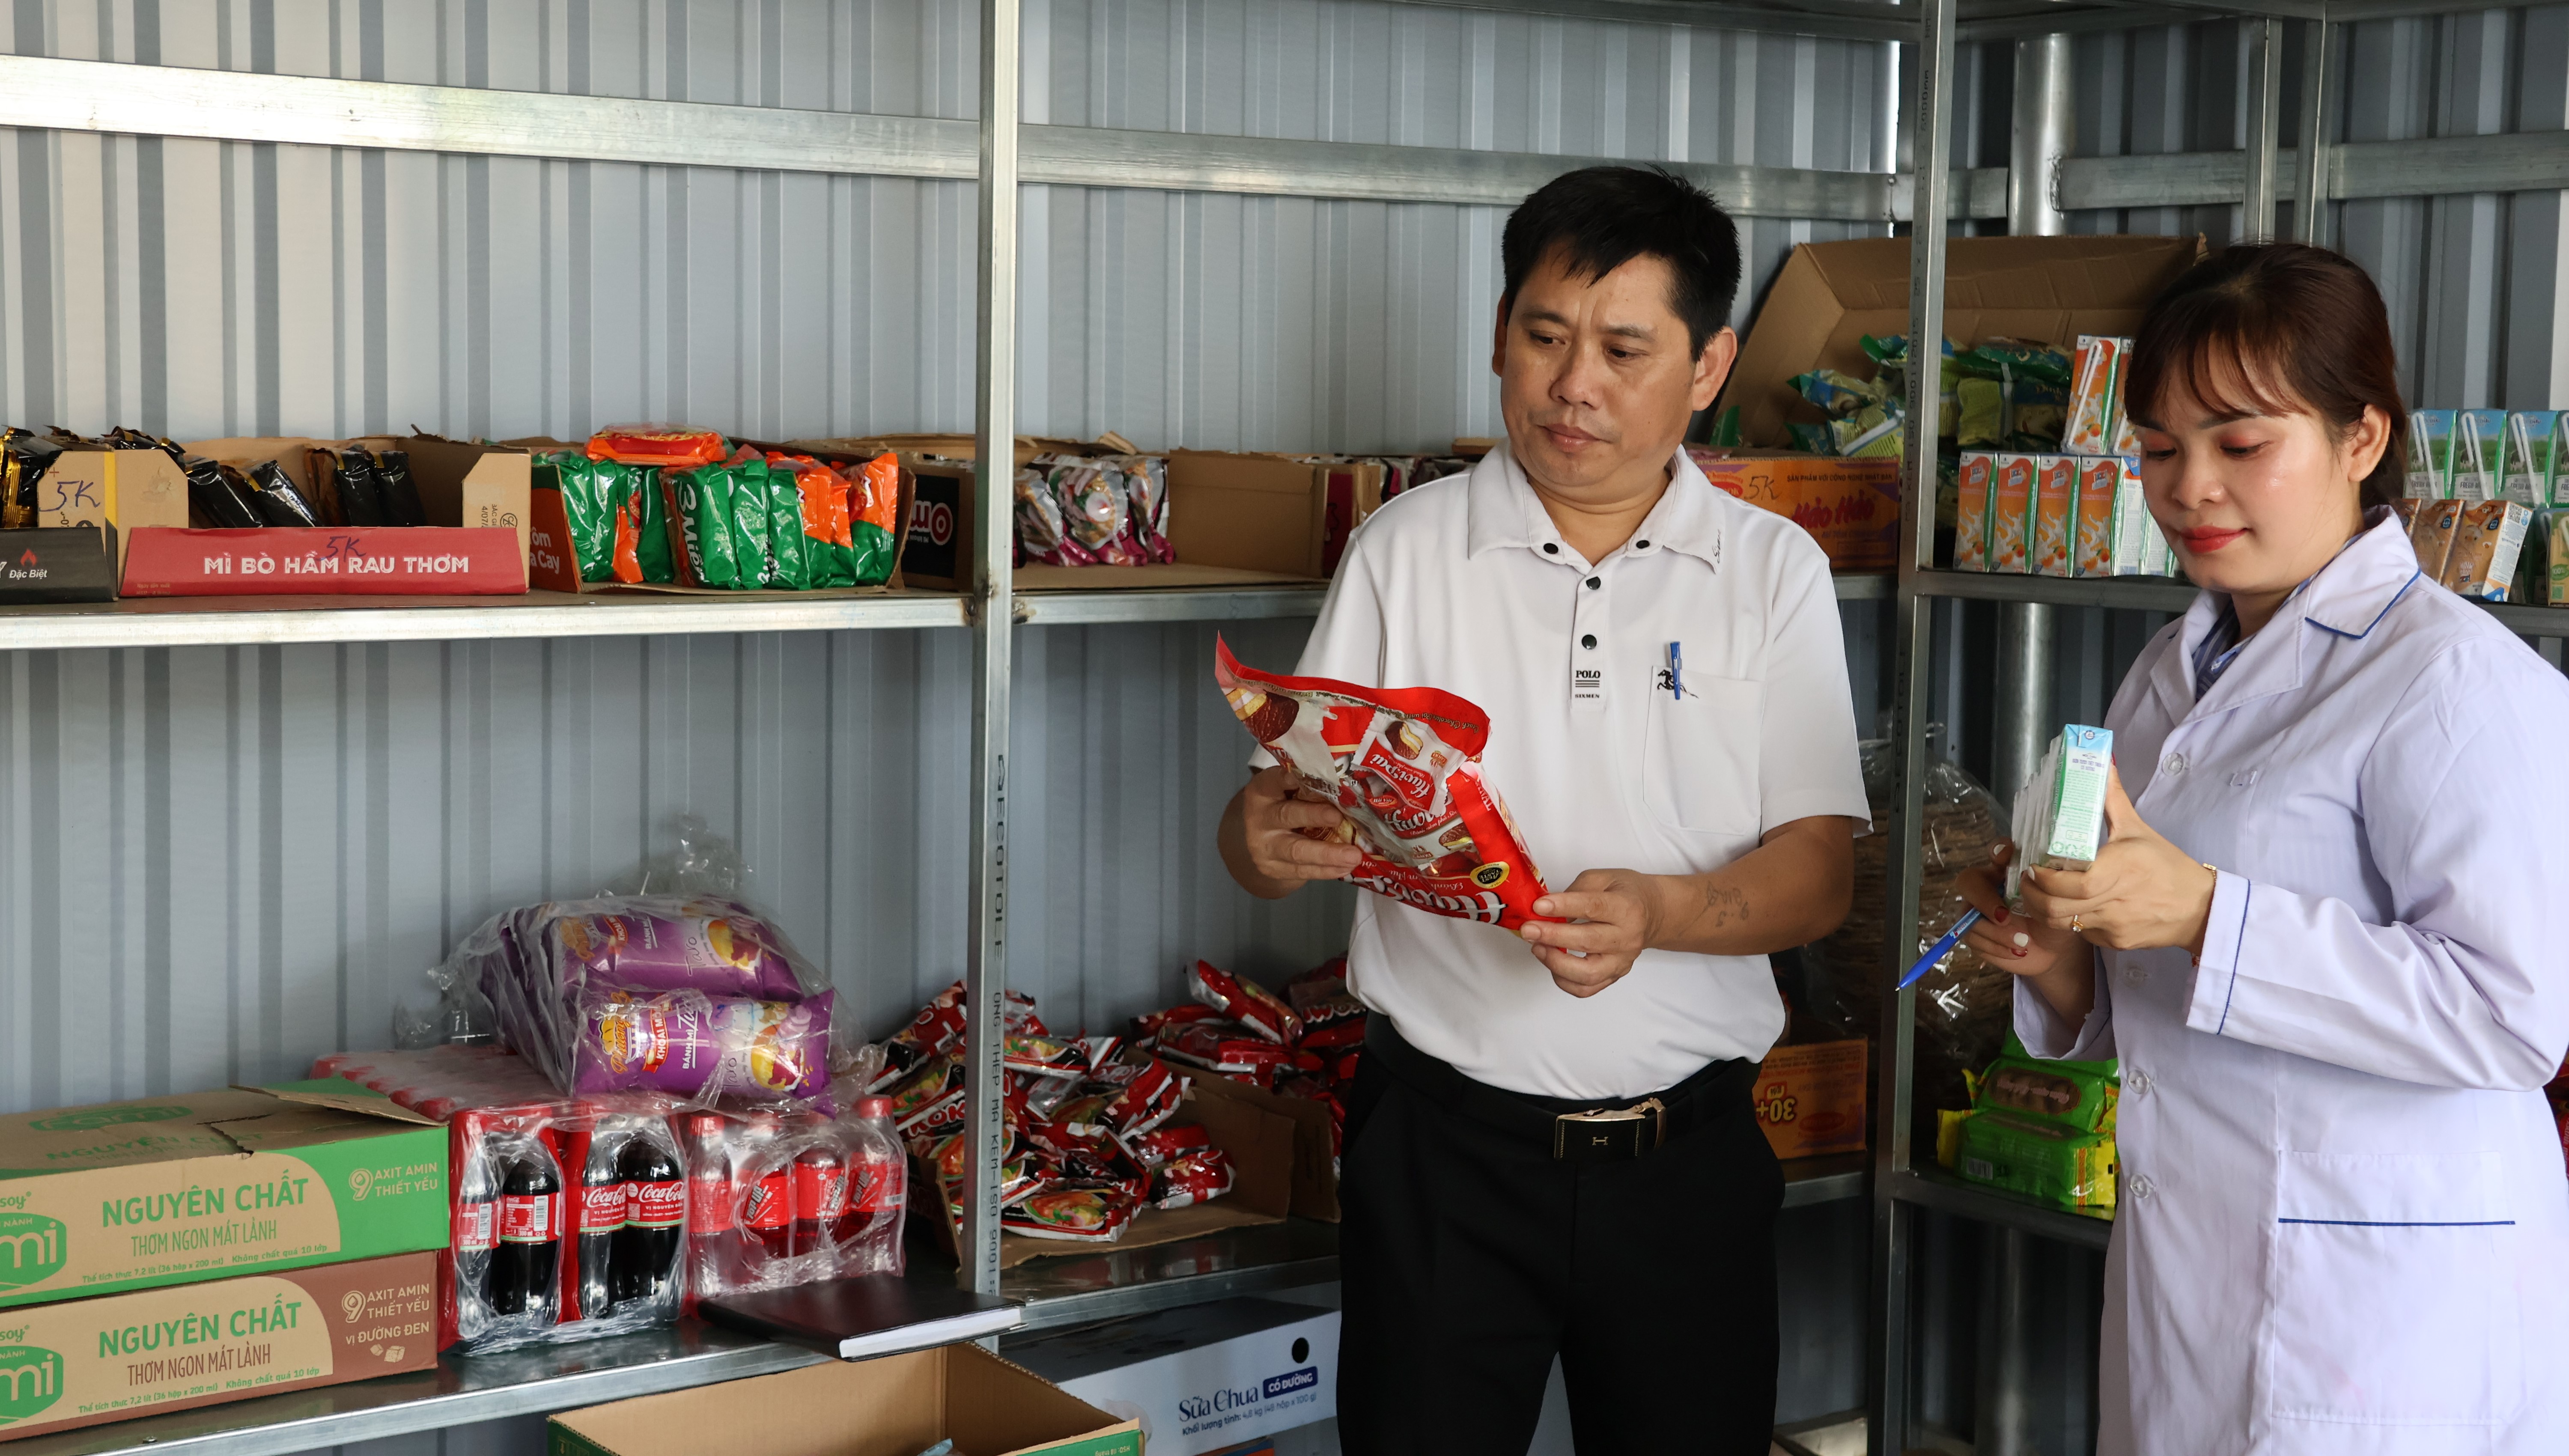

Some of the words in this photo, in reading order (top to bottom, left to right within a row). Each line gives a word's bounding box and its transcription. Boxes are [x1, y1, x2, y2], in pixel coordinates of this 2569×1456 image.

[39, 480, 101, 512] 5K
[1744, 476, 1780, 500] 5K
[316, 536, 367, 563] 5K
[530, 526, 551, 548] ôm
[9, 569, 28, 581] Đặc
[29, 569, 48, 580] Biệt
[204, 552, 231, 575] MÌ
[241, 551, 275, 575] BÒ
[284, 551, 339, 575] HẦM
[348, 557, 395, 574] RAU
[404, 553, 469, 574] THƠM
[538, 550, 560, 574] Cay
[1576, 670, 1601, 679] POLO
[994, 796, 1005, 962] ECOTOLE
[685, 936, 706, 977] Taro
[993, 992, 1002, 1027] ONG
[655, 1028, 666, 1060] KHOAI
[682, 1042, 693, 1069] BÁNH
[992, 1042, 1001, 1086] THEP
[908, 1099, 966, 1137] KOK
[991, 1099, 1000, 1123] MA
[1755, 1098, 1795, 1123] 30+
[46, 1133, 180, 1160] NGUYÊN
[375, 1167, 402, 1180] AXIT
[405, 1162, 438, 1176] AMIN
[990, 1134, 999, 1217] KEM-ISO
[349, 1168, 374, 1201] 9
[375, 1179, 411, 1197] THIẾT
[414, 1176, 438, 1191] YẾU
[751, 1185, 764, 1204] UP
[103, 1185, 224, 1227] NGUYÊN
[235, 1169, 309, 1211] CHẤT
[3, 1218, 33, 1228] NÀNH
[0, 1221, 57, 1268] mi
[131, 1233, 168, 1257] THƠM
[172, 1227, 209, 1252] NGON
[213, 1220, 240, 1246] MÁT
[243, 1216, 277, 1244] LÀNH
[232, 1254, 259, 1263] Không
[283, 1248, 298, 1257] quá
[301, 1246, 312, 1254] 10
[314, 1244, 327, 1252] lớp
[98, 1272, 113, 1280] tích
[195, 1259, 209, 1268] 200
[367, 1288, 395, 1302] AXIT
[397, 1283, 429, 1298] AMIN
[342, 1290, 367, 1324] 9
[367, 1300, 403, 1319] THIẾT
[406, 1296, 429, 1313] YẾU
[99, 1313, 220, 1358] NGUYÊN
[229, 1293, 301, 1337] CHẤT
[346, 1335, 355, 1346] VỊ
[358, 1325, 401, 1343] ĐƯỜNG
[404, 1321, 429, 1336] ĐEN
[0, 1353, 54, 1401] mi
[127, 1360, 164, 1387] THƠM
[168, 1353, 204, 1380] NGON
[209, 1344, 234, 1373] MÁT
[238, 1341, 271, 1368] LÀNH
[226, 1379, 252, 1389] Không
[276, 1371, 291, 1382] quá
[293, 1369, 304, 1378] 10
[307, 1367, 319, 1376] lớp
[1268, 1378, 1281, 1393] CÓ
[1282, 1372, 1313, 1390] ĐƯỜNG
[95, 1402, 109, 1411] tích
[130, 1396, 142, 1405] 7,2
[154, 1392, 166, 1401] (36
[190, 1385, 204, 1394] 200
[1179, 1396, 1211, 1422] Sữa
[1213, 1387, 1259, 1412] Chua
[1182, 1423, 1199, 1436] Khối
